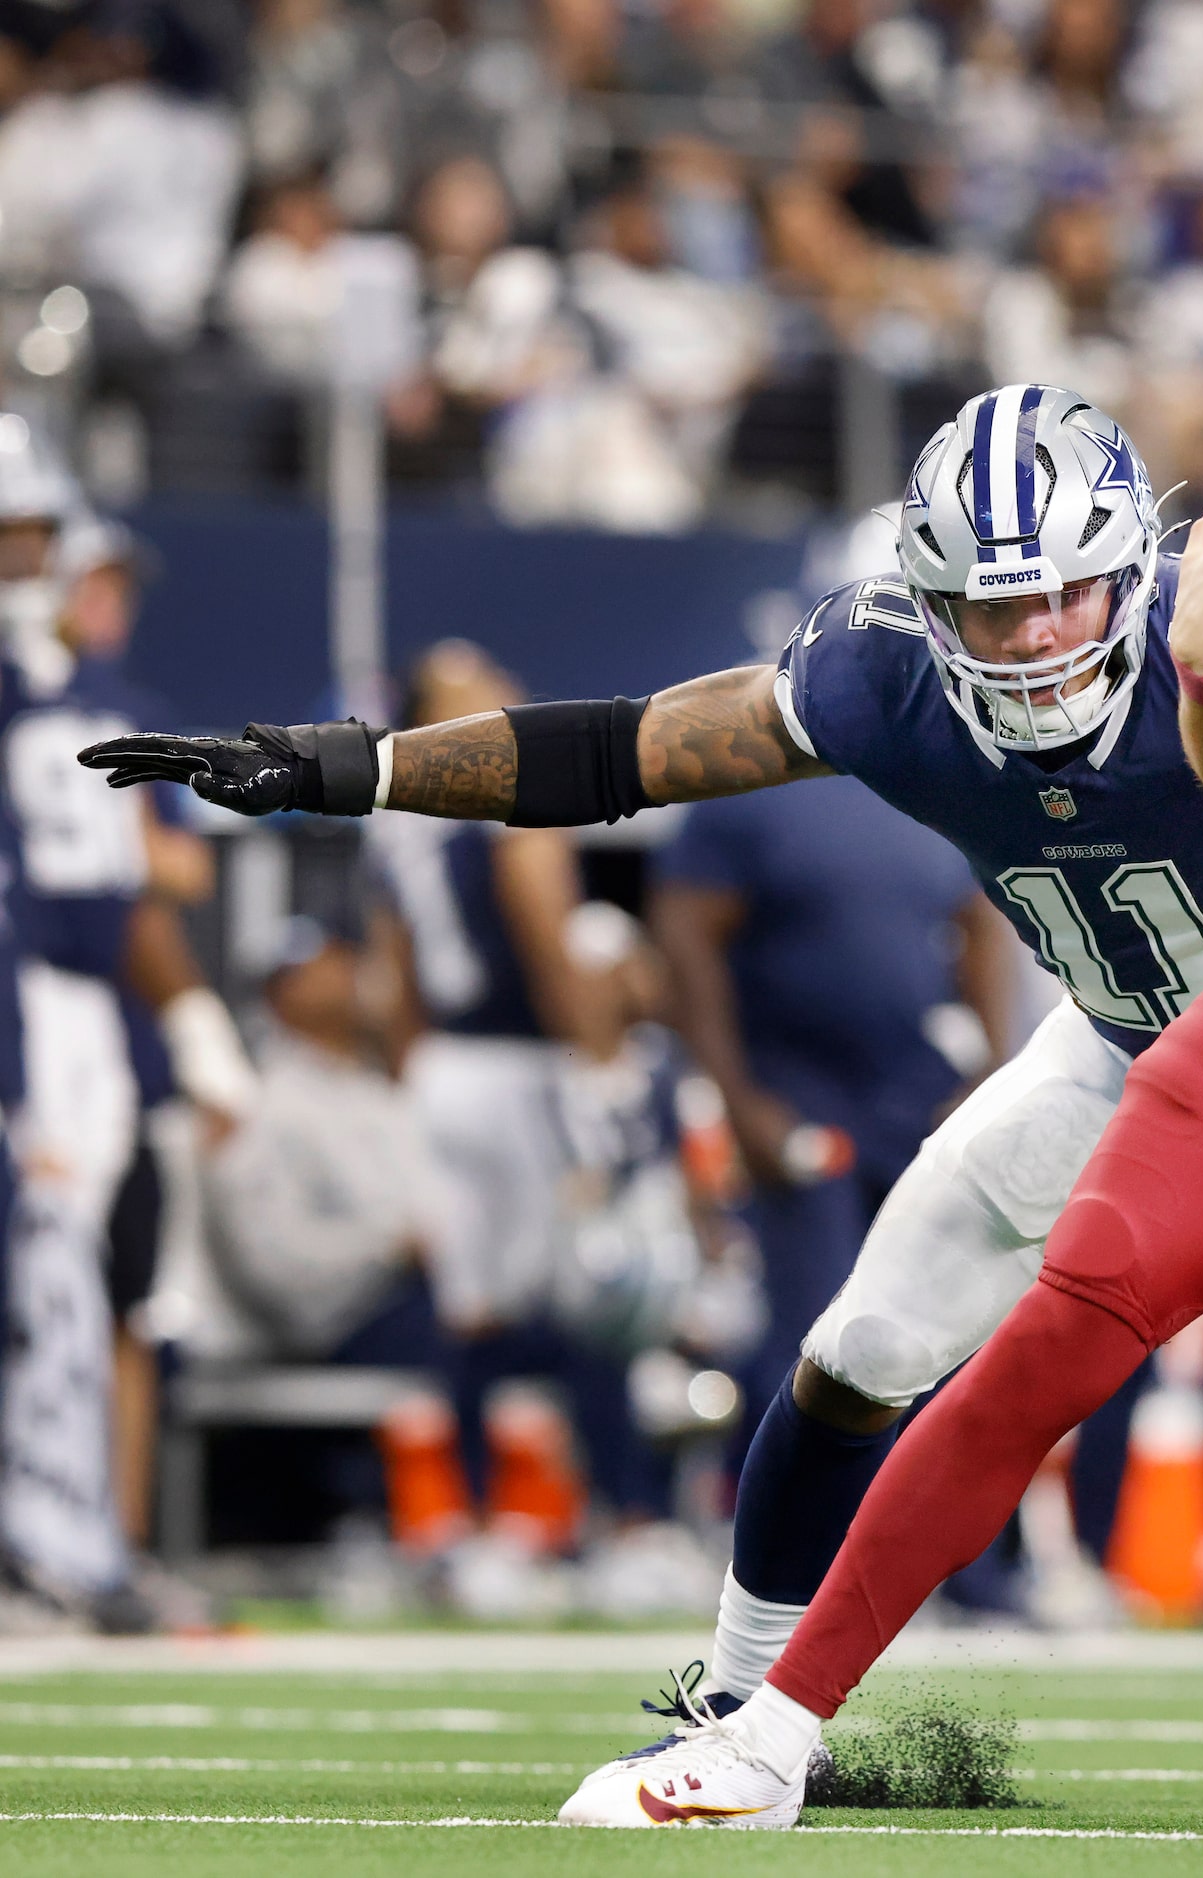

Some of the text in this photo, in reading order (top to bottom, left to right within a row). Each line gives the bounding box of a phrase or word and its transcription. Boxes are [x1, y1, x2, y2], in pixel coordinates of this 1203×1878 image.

[979, 569, 1041, 586] COWBOYS
[1049, 803, 1072, 815] NFL
[1042, 844, 1127, 859] COWBOYS
